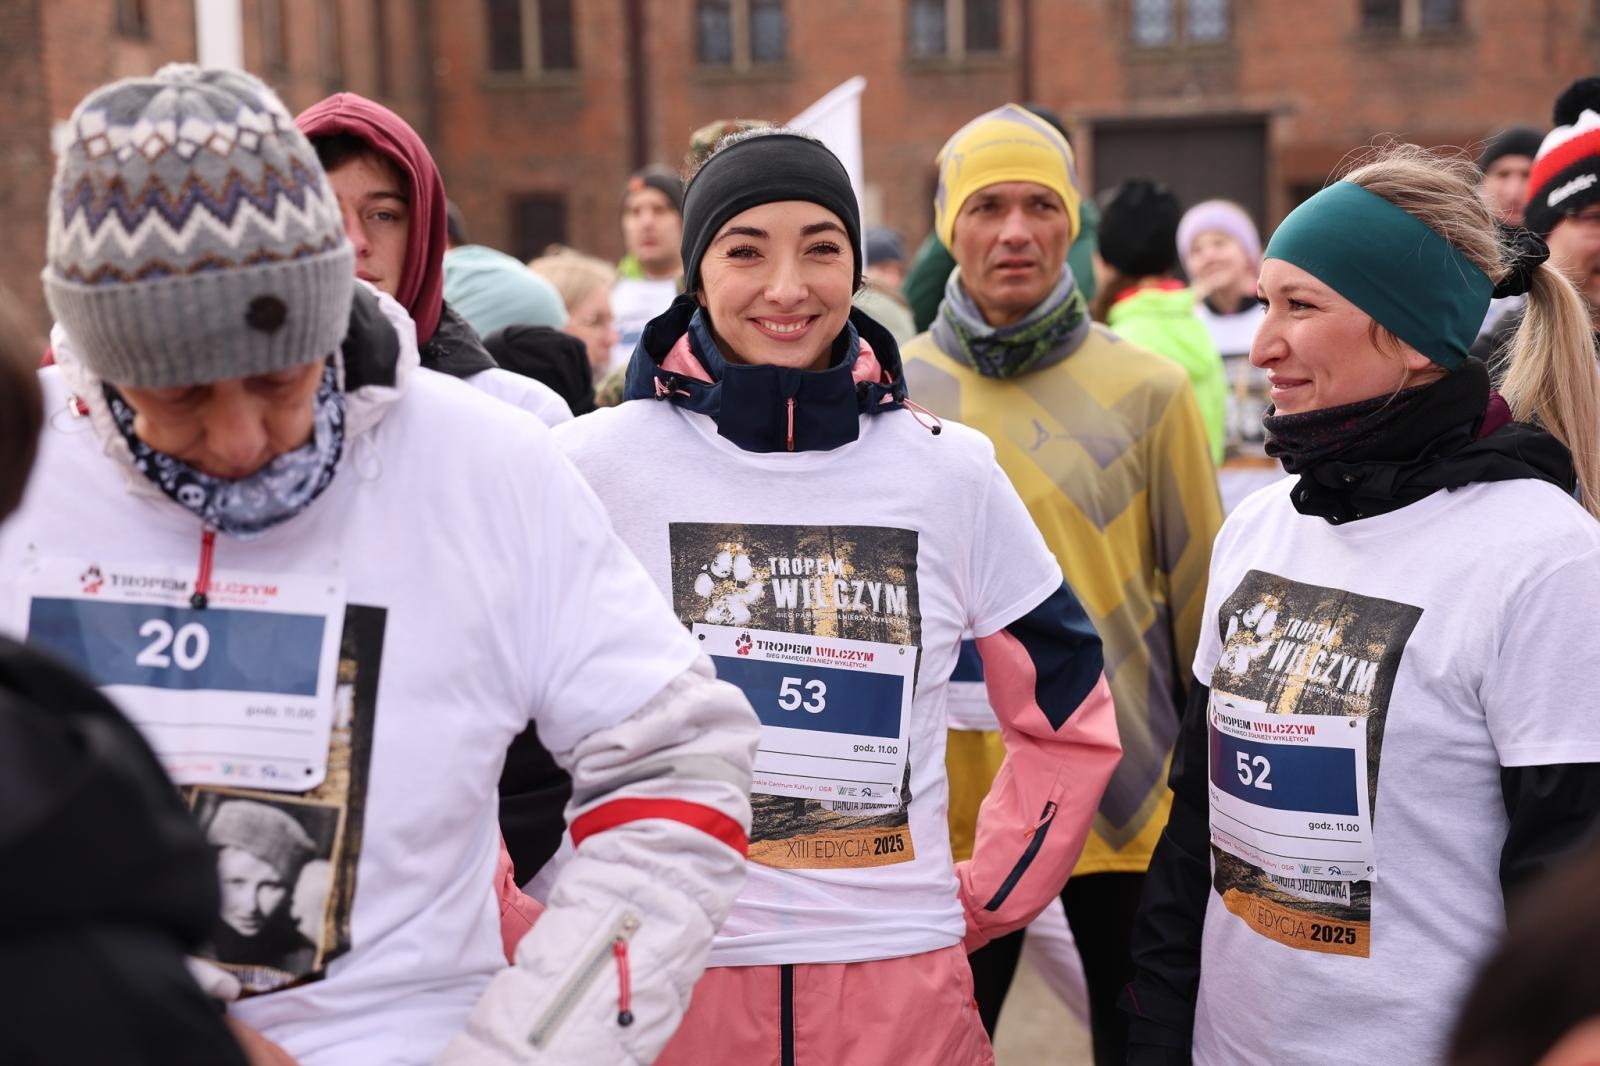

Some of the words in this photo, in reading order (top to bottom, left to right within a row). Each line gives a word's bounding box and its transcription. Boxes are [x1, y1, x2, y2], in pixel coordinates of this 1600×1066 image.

[768, 557, 844, 577] TROPEM
[772, 578, 908, 616] WILCZYM
[136, 619, 210, 671] 20
[1284, 617, 1338, 645] TROPEM
[757, 640, 812, 655] TROPEM
[815, 646, 874, 662] WILCZYM
[1268, 639, 1378, 697] WILCZYM
[777, 676, 827, 714] 53
[1254, 722, 1315, 735] WILCZYM
[853, 743, 877, 754] godz.
[878, 744, 898, 755] 11.00
[1236, 750, 1273, 791] 52
[1308, 821, 1334, 831] godz.
[1336, 822, 1360, 833] 11.00
[815, 839, 871, 859] EDYCJA
[873, 834, 905, 856] 2025
[1258, 905, 1306, 939] EDYCJA
[1311, 923, 1356, 945] 2025
